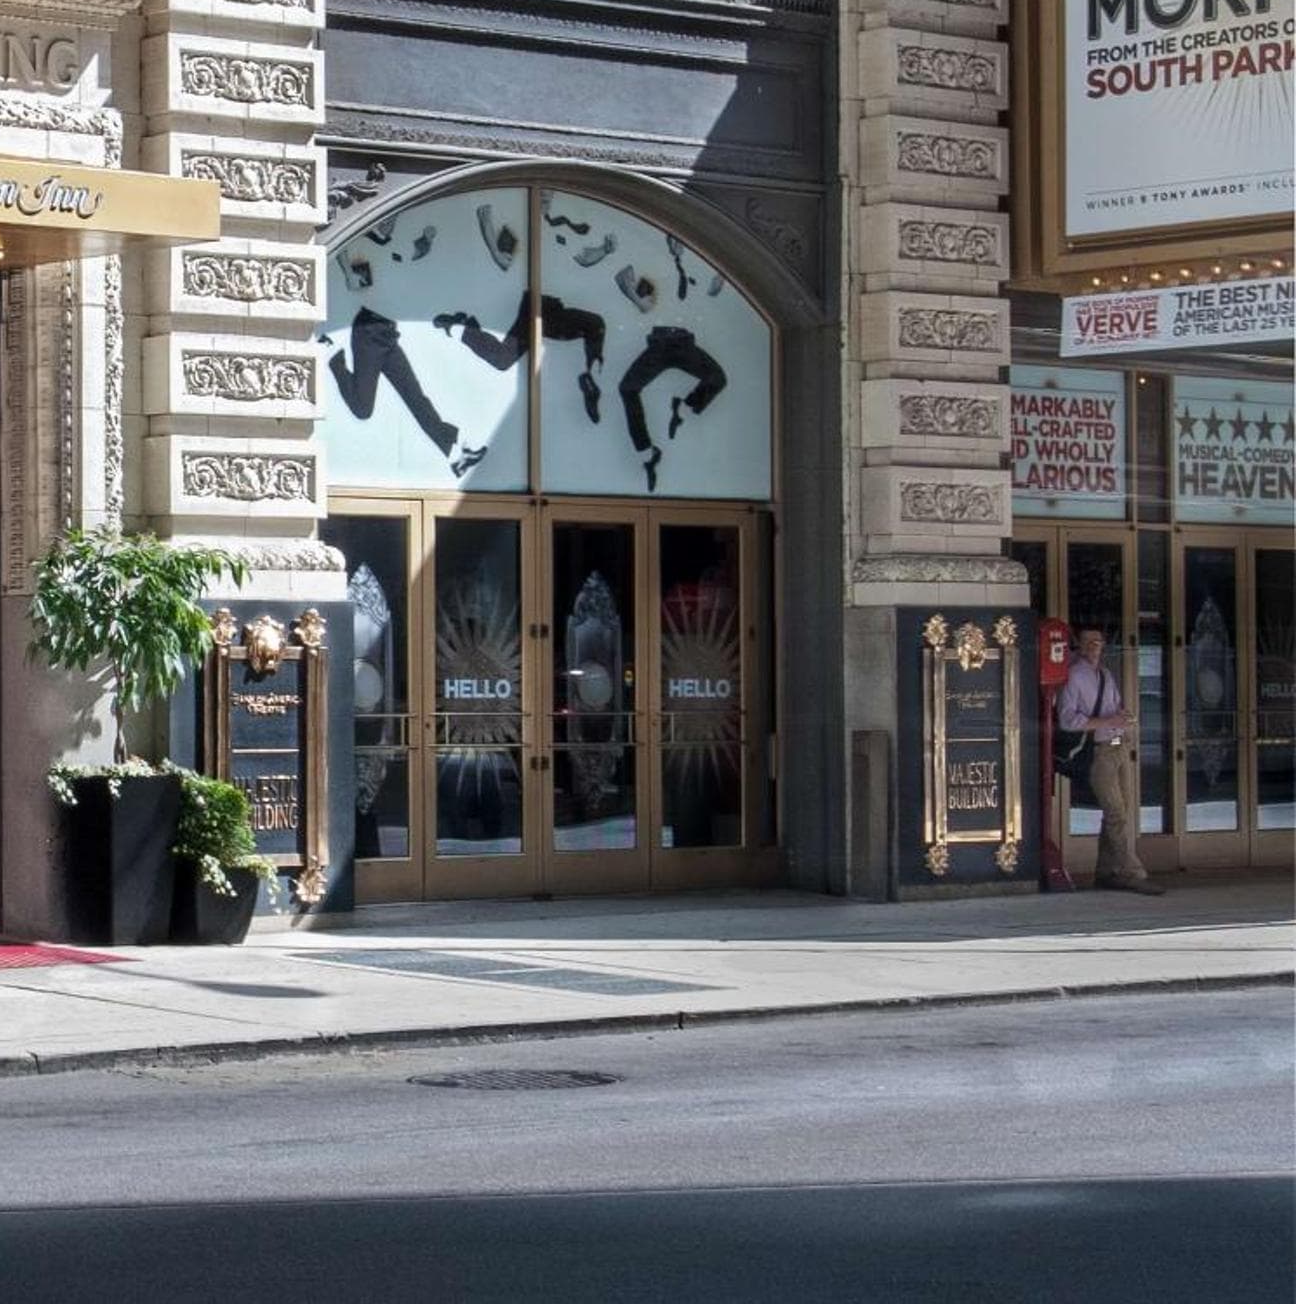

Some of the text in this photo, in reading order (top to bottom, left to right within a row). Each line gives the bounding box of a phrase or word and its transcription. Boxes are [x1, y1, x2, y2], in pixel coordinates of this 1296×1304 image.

[1088, 44, 1137, 65] FROM
[1142, 38, 1176, 57] THE
[1181, 20, 1279, 53] CREATORS
[1087, 54, 1202, 99] SOUTH
[17, 175, 103, 219] Inn
[1085, 195, 1134, 210] WINNER
[1152, 191, 1186, 203] TONY
[1175, 290, 1215, 309] THE
[1220, 284, 1271, 305] BEST
[1076, 309, 1157, 336] VERVE
[1174, 304, 1253, 324] AMERICAN
[1173, 324, 1190, 337] OF
[1193, 321, 1219, 335] THE
[1223, 318, 1257, 333] LAST
[1260, 318, 1277, 330] 25
[1035, 440, 1114, 464] WHOLLY
[1179, 444, 1294, 464] MUSICAL-COMED
[444, 678, 512, 700] HELLO
[668, 678, 731, 699] HELLO
[948, 786, 997, 809] BUILDING
[253, 803, 299, 830] ILDING
